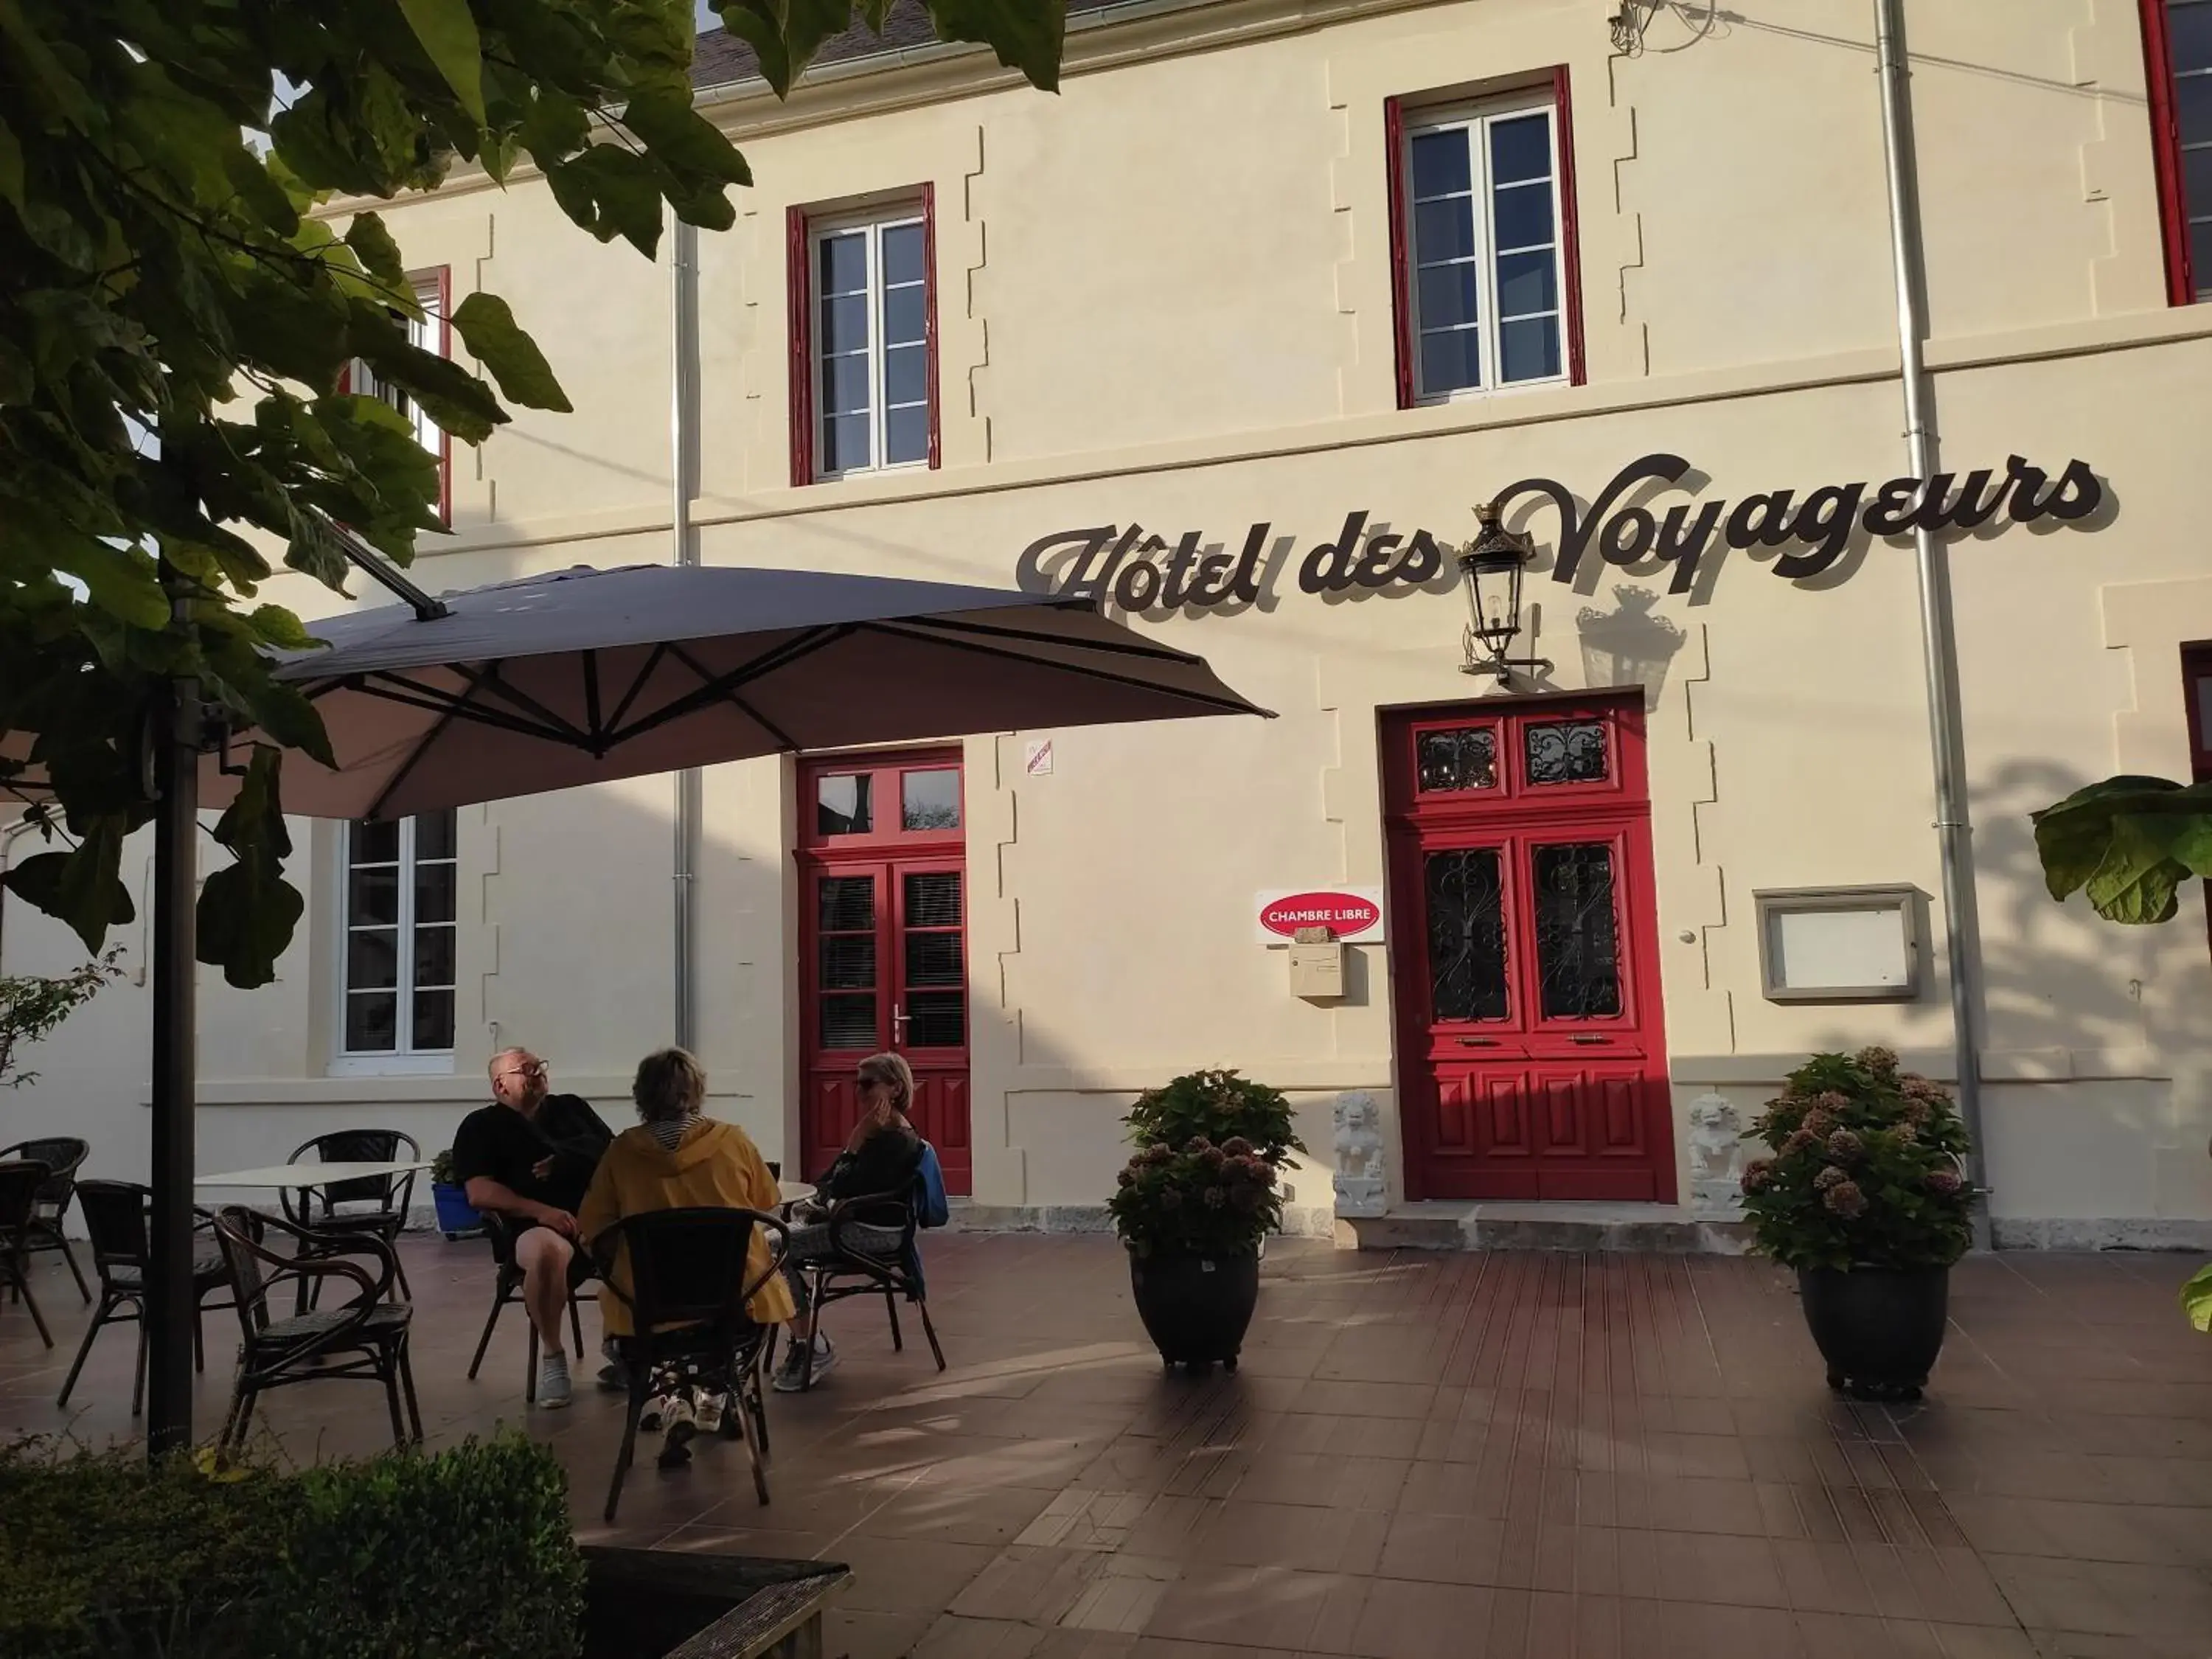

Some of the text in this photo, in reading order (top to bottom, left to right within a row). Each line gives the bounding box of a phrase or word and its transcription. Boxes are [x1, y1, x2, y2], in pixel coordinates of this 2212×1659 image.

[1016, 453, 2102, 616] Hôtel des Voyageurs
[1269, 908, 1371, 922] CHAMBRE LIBRE
